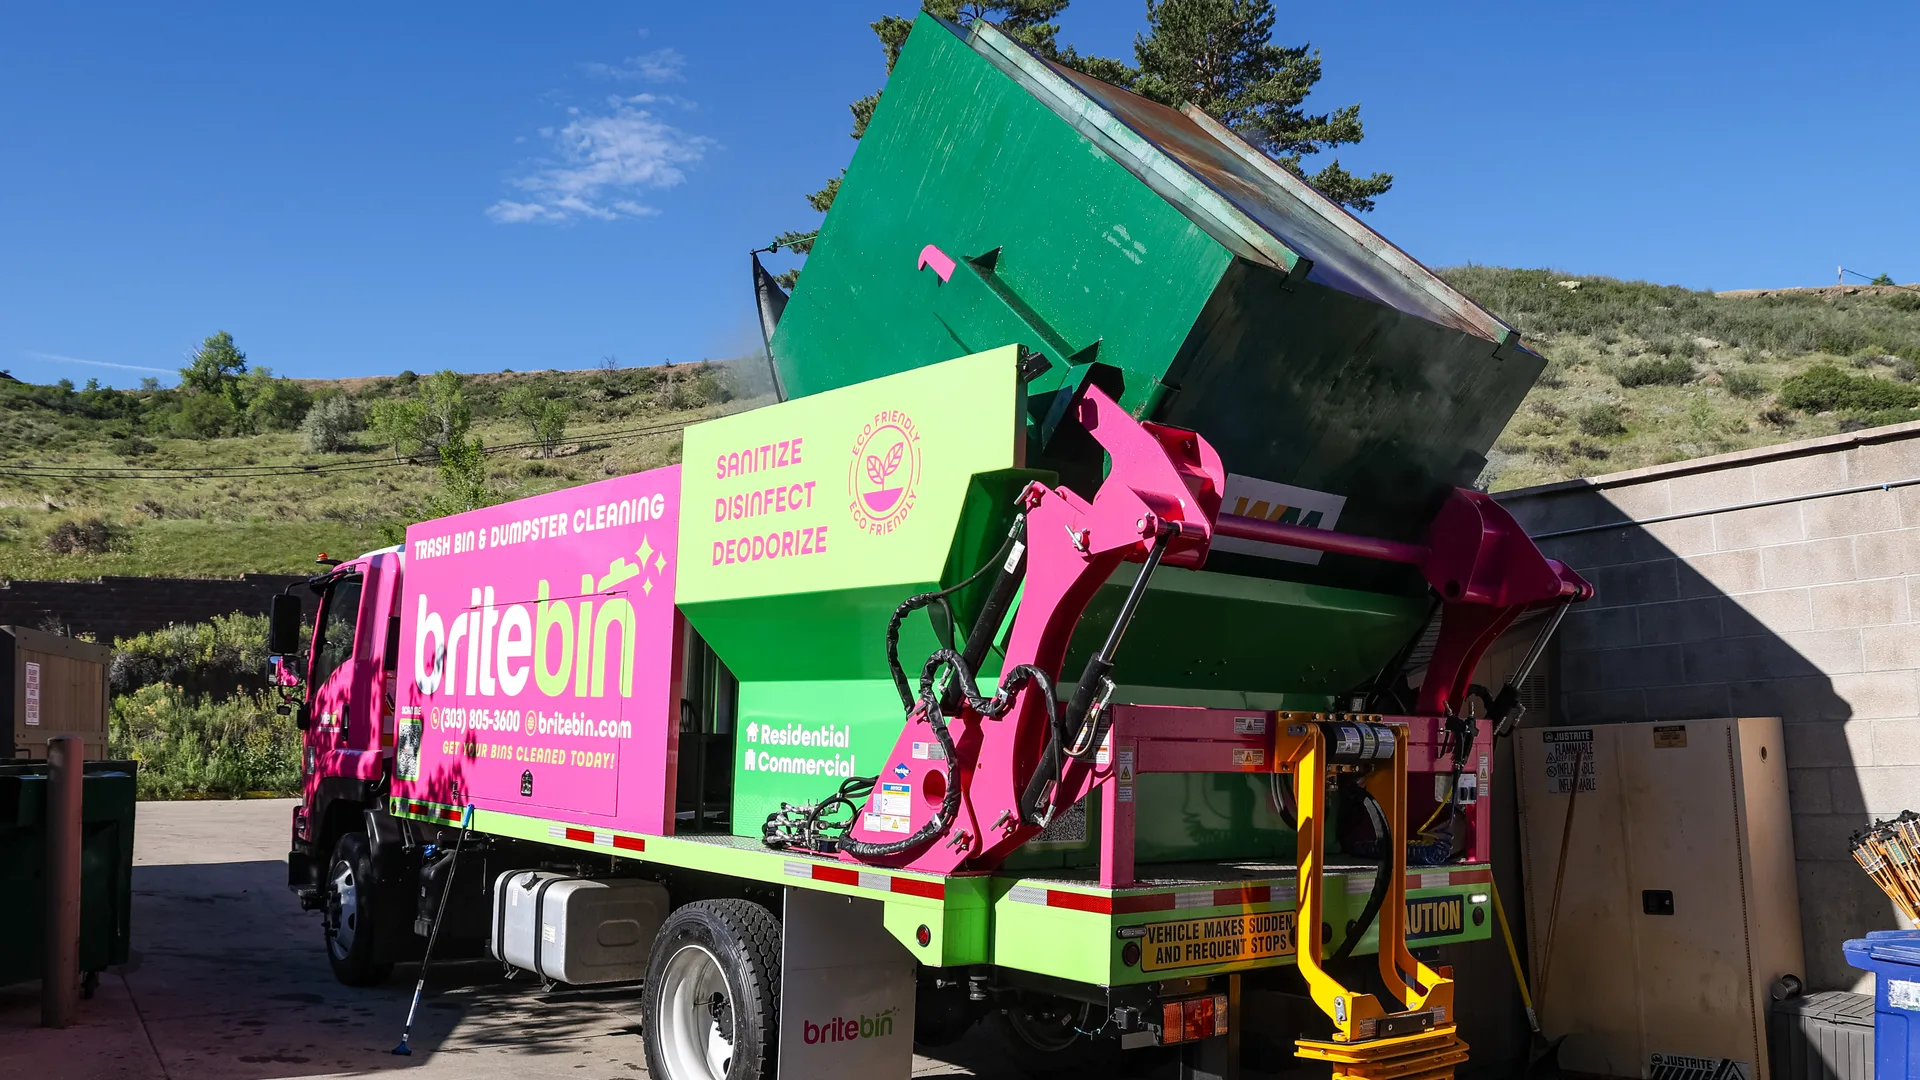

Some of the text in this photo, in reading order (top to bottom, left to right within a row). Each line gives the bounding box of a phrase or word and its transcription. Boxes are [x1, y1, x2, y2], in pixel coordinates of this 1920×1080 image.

[852, 410, 920, 456] ECO FRIENDLY
[716, 438, 803, 480] SANITIZE
[714, 481, 816, 523] DISINFECT
[849, 489, 916, 536] ECO FRIENDLY
[414, 493, 665, 560] TRASH BIN & DUMPSTER CLEANING
[712, 526, 828, 566] DEODORIZE
[414, 573, 636, 698] britebin
[440, 707, 632, 739] (303) 805-3600 britebin.com
[761, 723, 850, 748] Residential
[1554, 732, 1590, 741] JUSTRITE
[442, 741, 615, 769] GET YOUR BINS CLEANED TODAY!
[758, 753, 855, 778] Commercial
[1147, 914, 1293, 944] VEHICLE MAKES SUDDEN
[1156, 934, 1287, 964] AND FREQUENT STOPS
[804, 1012, 893, 1044] britebin
[1664, 1056, 1713, 1069] JUSTRITE
